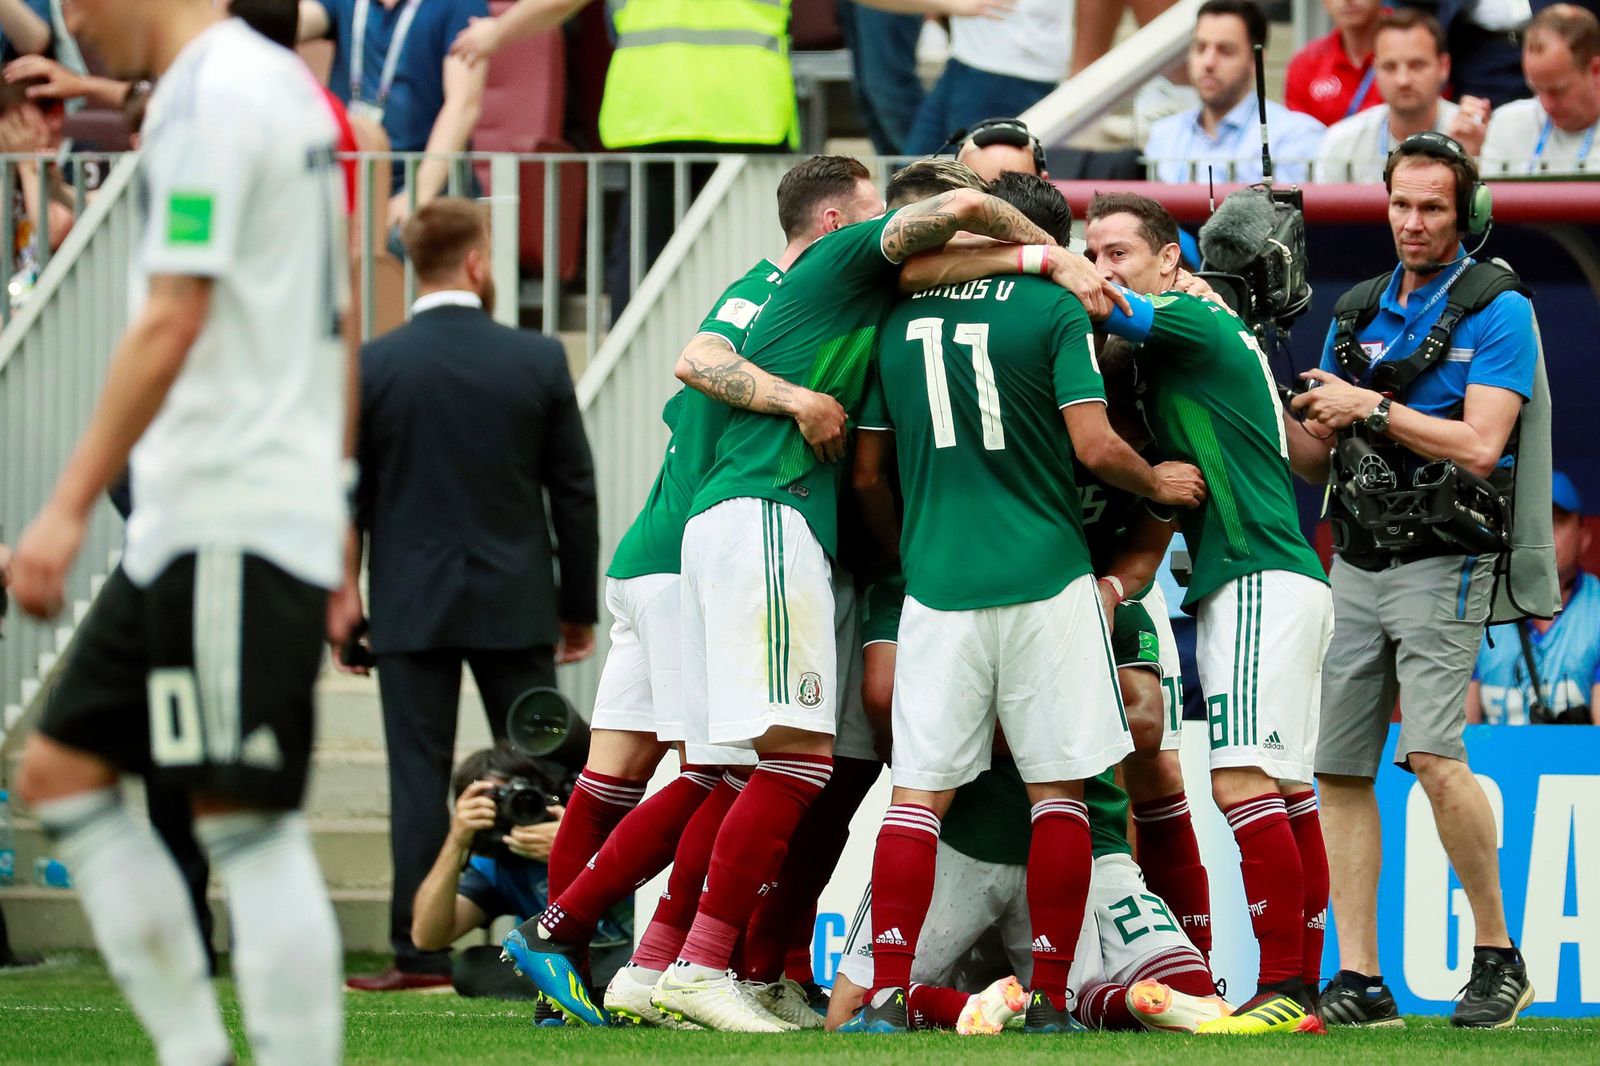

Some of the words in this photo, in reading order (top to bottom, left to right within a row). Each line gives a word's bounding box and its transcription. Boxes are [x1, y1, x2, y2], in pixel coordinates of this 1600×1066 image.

[905, 317, 1006, 451] 11
[1262, 742, 1285, 751] adidas
[1108, 894, 1179, 945] 23
[1182, 914, 1210, 928] FMF
[875, 937, 908, 946] adidas
